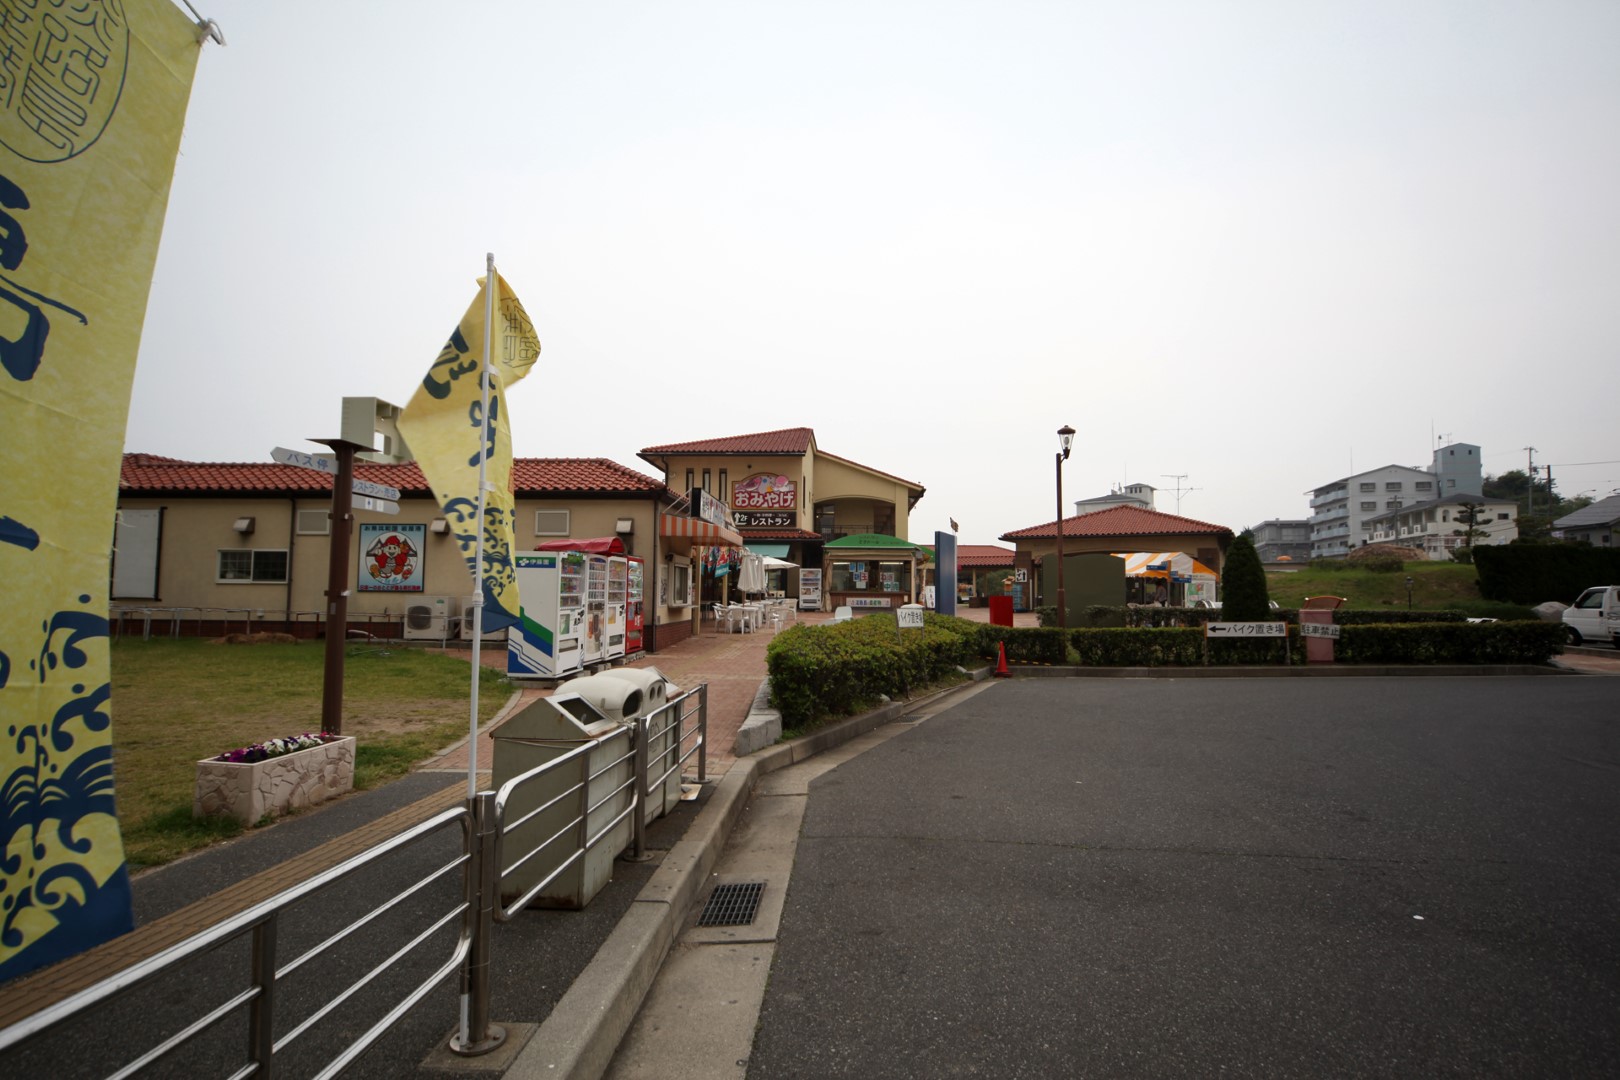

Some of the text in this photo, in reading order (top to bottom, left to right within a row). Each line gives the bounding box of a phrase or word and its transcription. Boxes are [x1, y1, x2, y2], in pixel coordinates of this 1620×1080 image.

[286, 453, 328, 470] バス停
[734, 491, 795, 508] おみやげ
[751, 517, 791, 526] レストラン
[1227, 623, 1285, 635] バイク置き場
[1301, 624, 1340, 637] 駐車禁止
